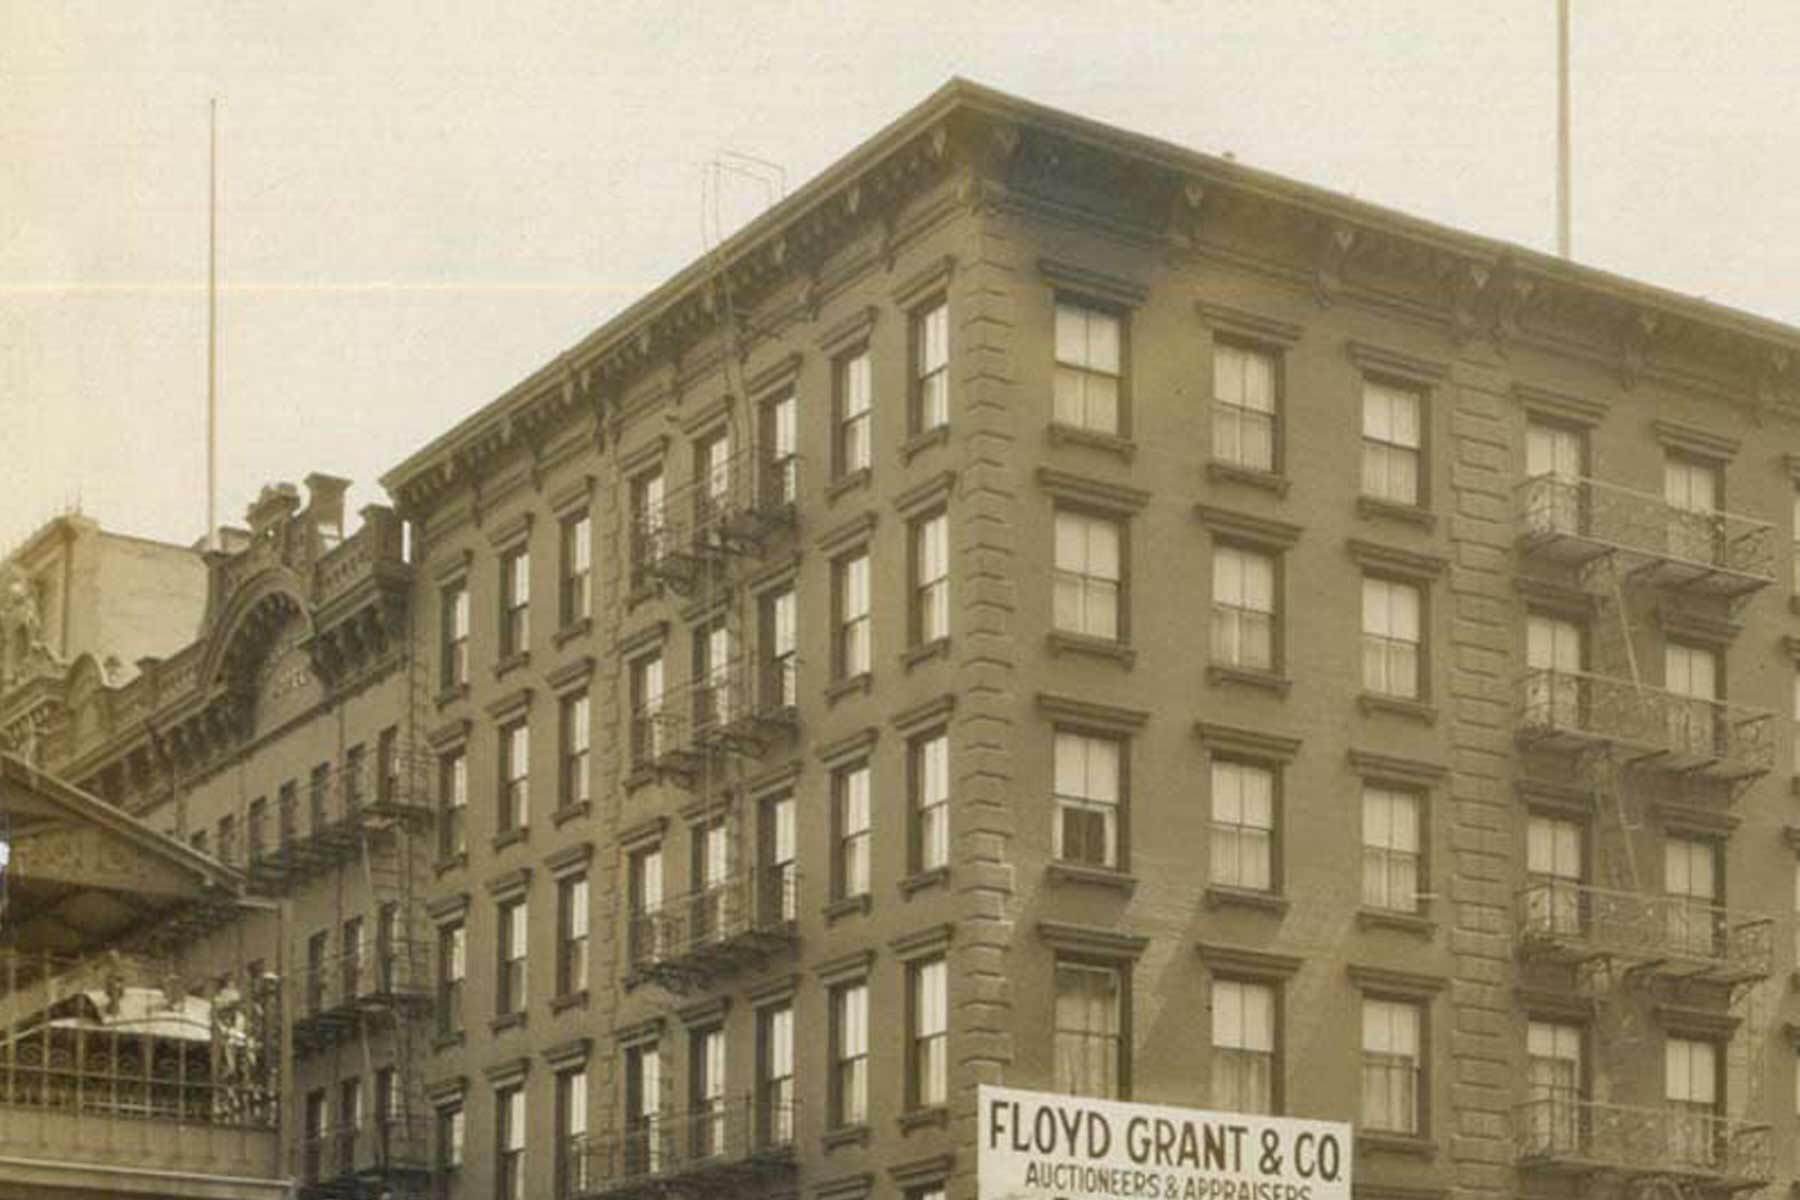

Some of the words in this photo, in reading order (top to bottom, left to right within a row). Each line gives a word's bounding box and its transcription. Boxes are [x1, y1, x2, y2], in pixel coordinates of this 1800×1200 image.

[989, 1099, 1112, 1160] FLOYD
[1126, 1115, 1249, 1173] GRANT
[1258, 1128, 1284, 1176] &
[1024, 1161, 1161, 1199] AUCTIONEERS
[1164, 1174, 1179, 1200] &
